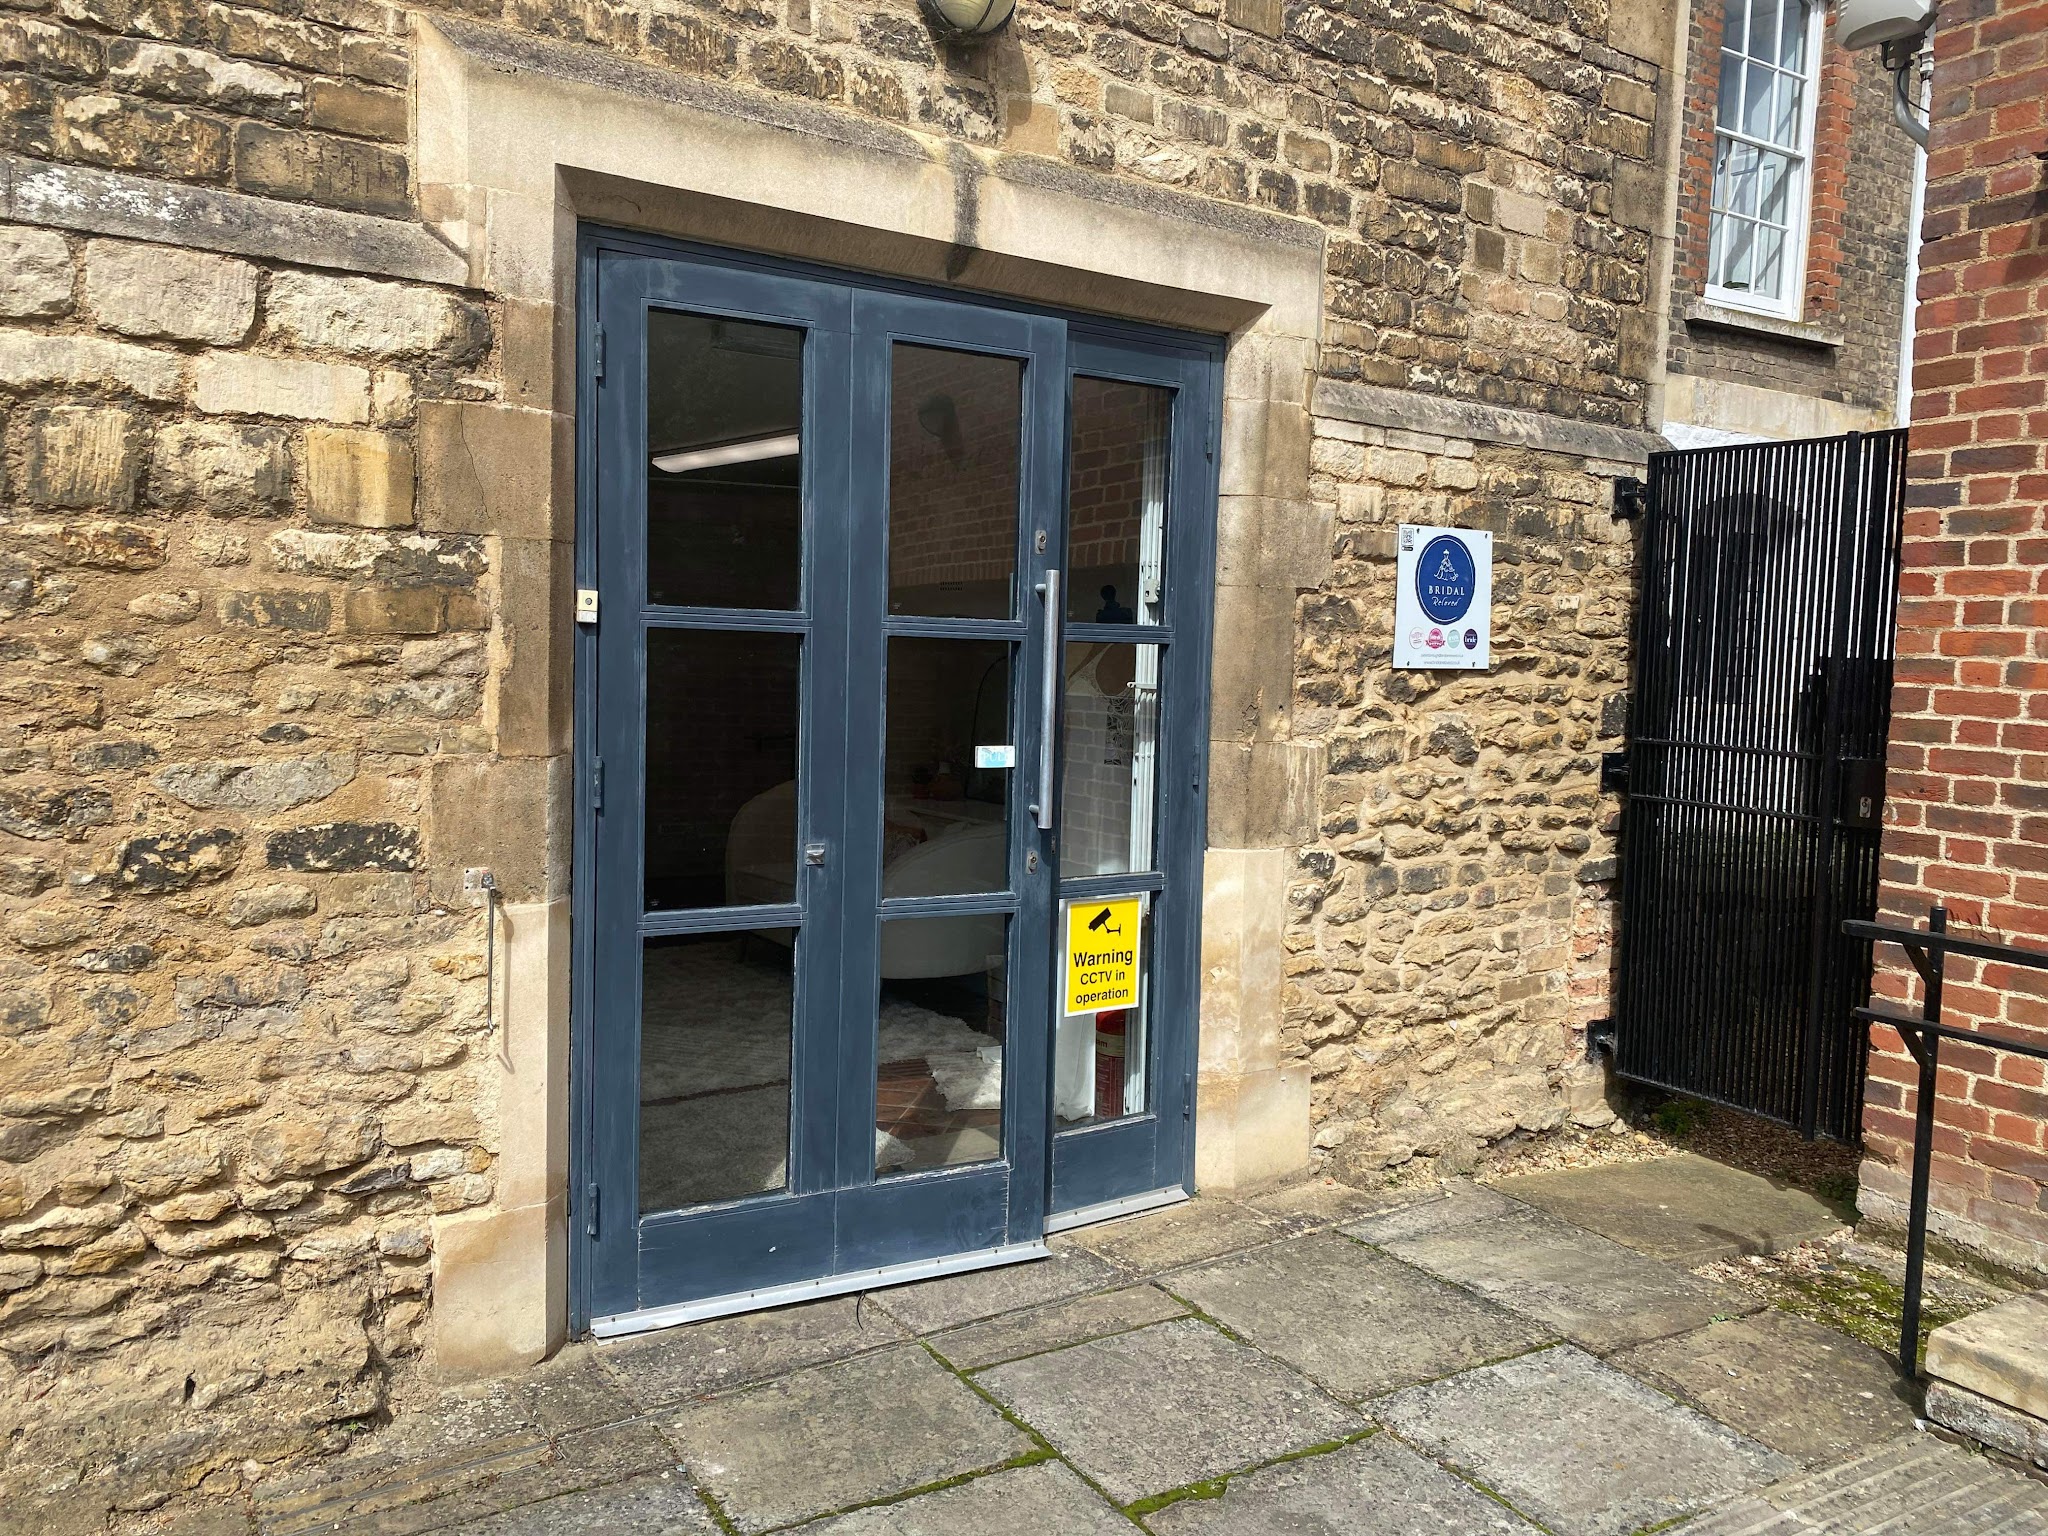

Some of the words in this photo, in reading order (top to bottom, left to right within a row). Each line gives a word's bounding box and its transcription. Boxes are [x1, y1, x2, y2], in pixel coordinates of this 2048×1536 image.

[1428, 585, 1465, 596] BRIDAL
[1431, 596, 1462, 606] Reloved
[1073, 949, 1133, 968] Warning
[1080, 970, 1113, 985] CCTV
[1115, 969, 1125, 981] in
[1075, 988, 1129, 1005] operation
